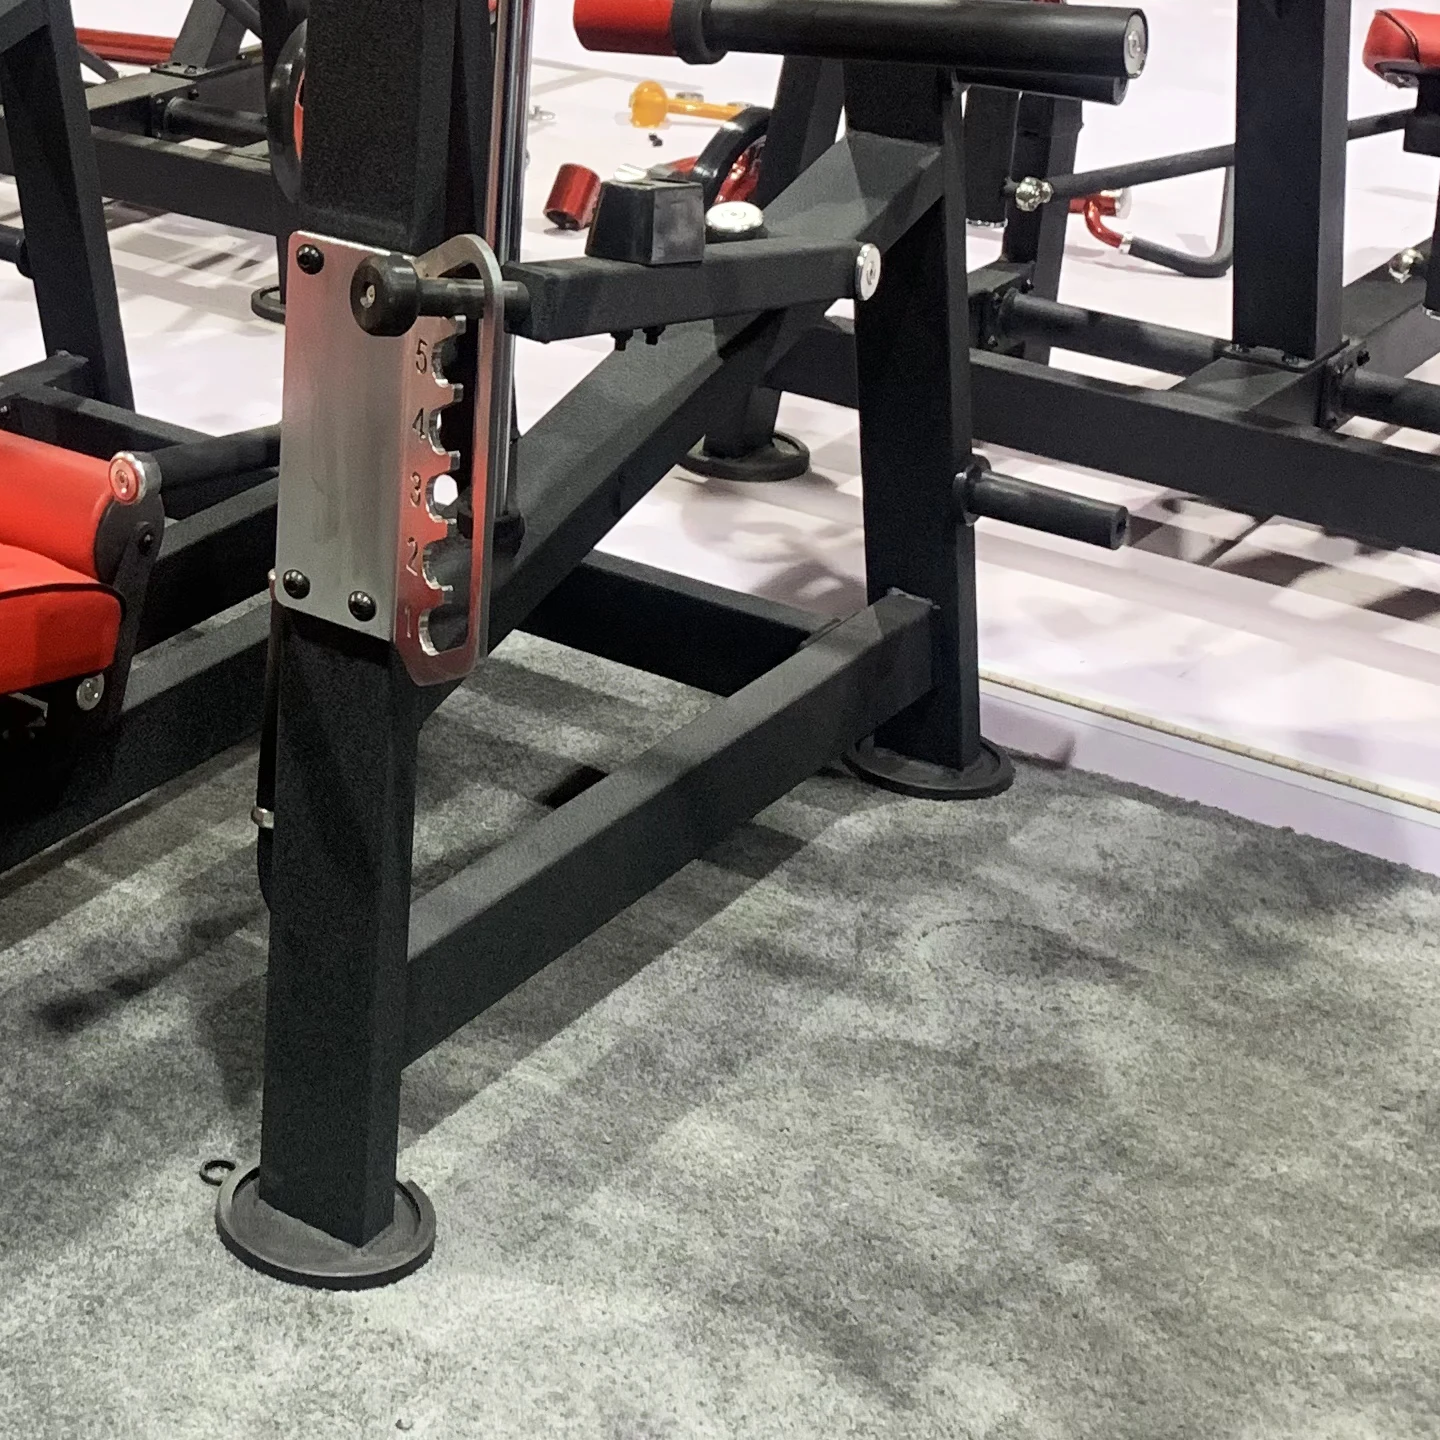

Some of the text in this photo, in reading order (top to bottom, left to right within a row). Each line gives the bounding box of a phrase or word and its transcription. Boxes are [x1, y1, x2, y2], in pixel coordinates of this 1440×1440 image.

[415, 340, 427, 373] 5
[412, 408, 426, 442] 4
[410, 472, 421, 506] 3
[406, 537, 419, 576] 2
